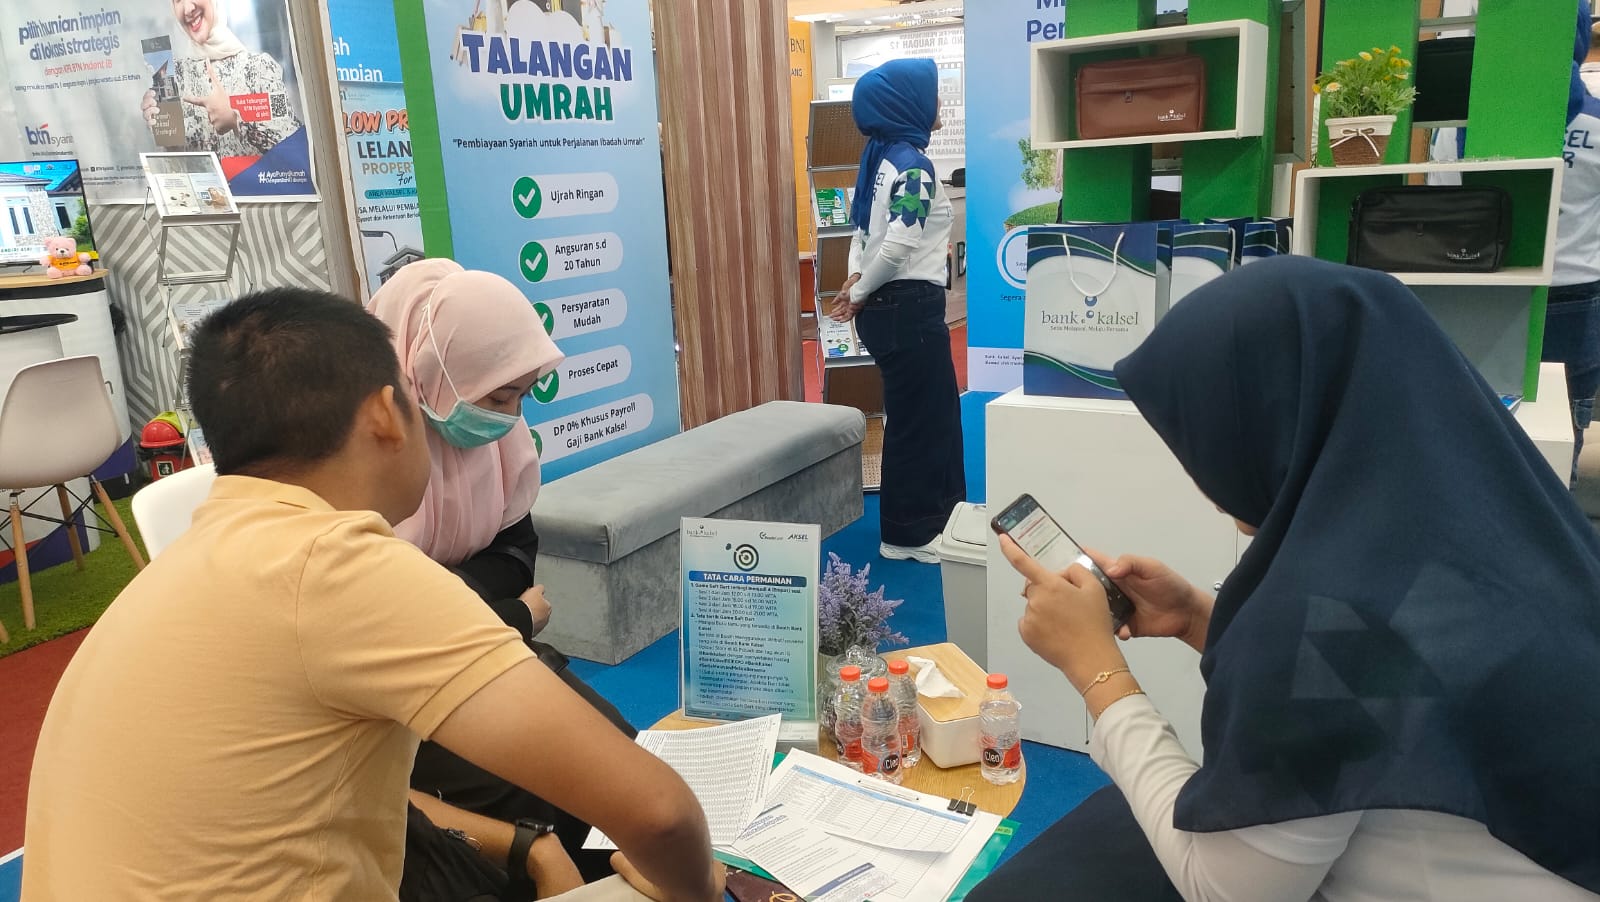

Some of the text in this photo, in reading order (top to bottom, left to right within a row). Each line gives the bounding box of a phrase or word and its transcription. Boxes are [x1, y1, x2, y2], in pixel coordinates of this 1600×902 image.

[19, 8, 121, 45] pilih hunian impian
[1027, 20, 1065, 42] Per
[30, 31, 120, 60] di lokasi strategis
[333, 37, 350, 56] ah
[790, 38, 806, 53] BNI
[462, 33, 633, 81] TALANGAN
[337, 63, 384, 82] mpian
[500, 83, 613, 121] UMRAH
[343, 111, 381, 135] LOW
[25, 124, 50, 145] btn
[452, 138, 508, 150] "Pembiayaan
[509, 138, 538, 150] Syariah
[539, 138, 561, 147] untuk
[562, 138, 599, 149] Perjalanan
[600, 137, 622, 147] Ibadah
[1564, 130, 1594, 149] EL
[357, 140, 412, 159] LELAN
[362, 162, 414, 175] PROPER
[397, 171, 413, 186] For
[550, 188, 604, 204] Ujrah Ringan
[369, 204, 396, 213] MELALUI
[554, 239, 607, 257] Angsuran s.d
[564, 257, 601, 271] 20 Tahun
[561, 296, 610, 314] Persyaratan
[573, 314, 601, 329] Mudah
[1041, 311, 1139, 325] bank kalsel
[568, 359, 618, 380] Proses Cepat
[553, 402, 636, 437] DP 0% Khusus Payroll
[566, 420, 627, 449] Gaji Bank Kalsel
[704, 573, 792, 585] TATA CARA PERMAINAN
[885, 758, 900, 770] Cleo
[984, 751, 1000, 763] Cleo
